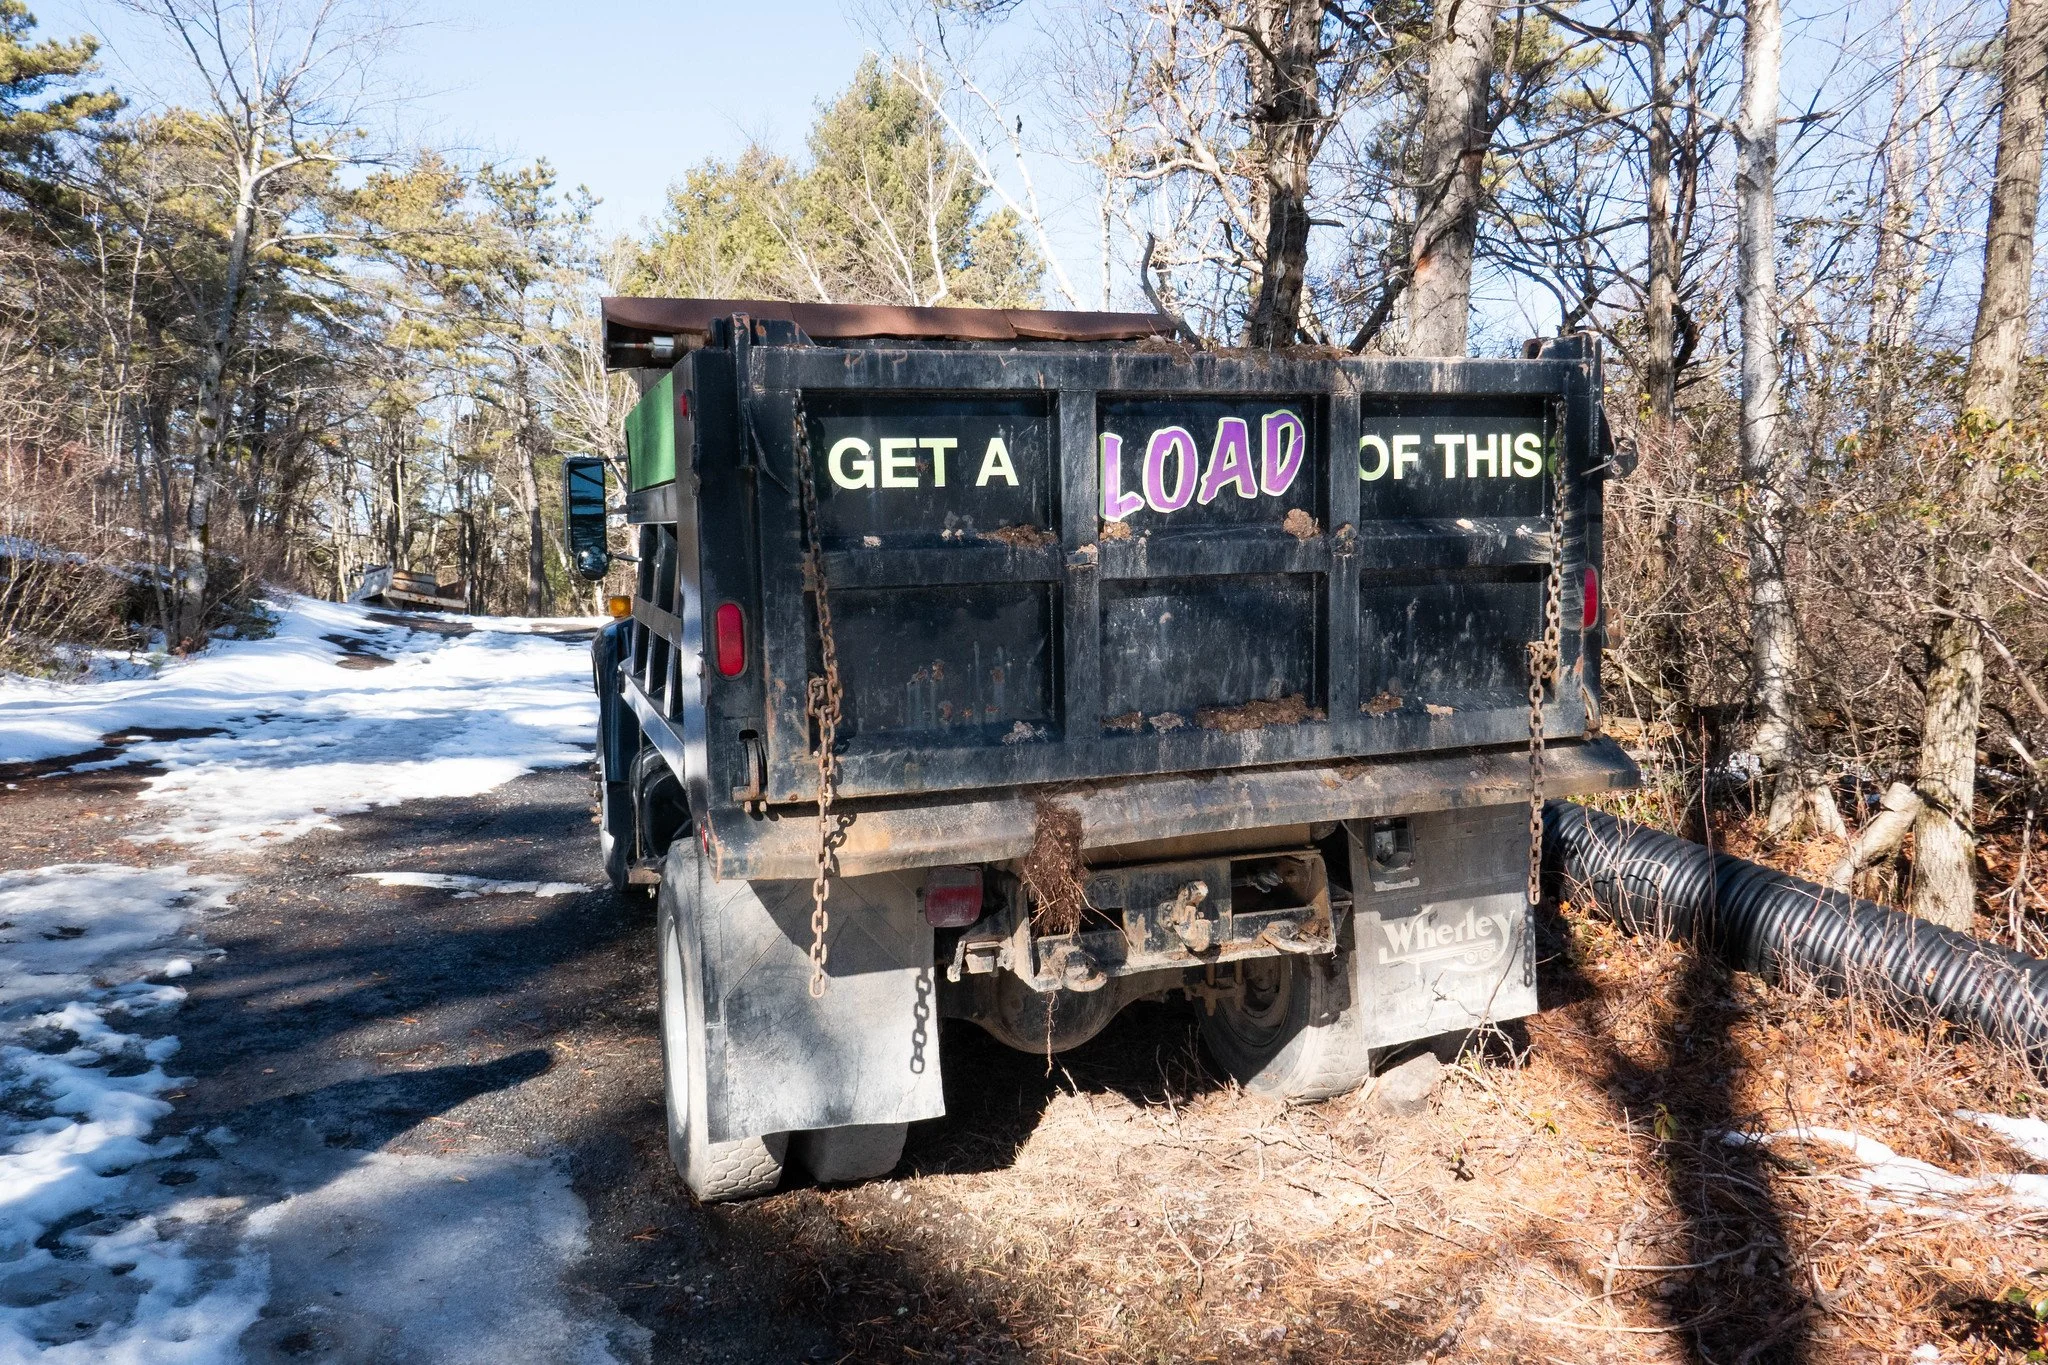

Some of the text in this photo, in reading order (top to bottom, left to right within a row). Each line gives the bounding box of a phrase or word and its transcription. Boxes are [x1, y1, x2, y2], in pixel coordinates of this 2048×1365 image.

[827, 409, 1543, 523] GET A LOAD OF THIS
[1381, 904, 1516, 968] Wherley
